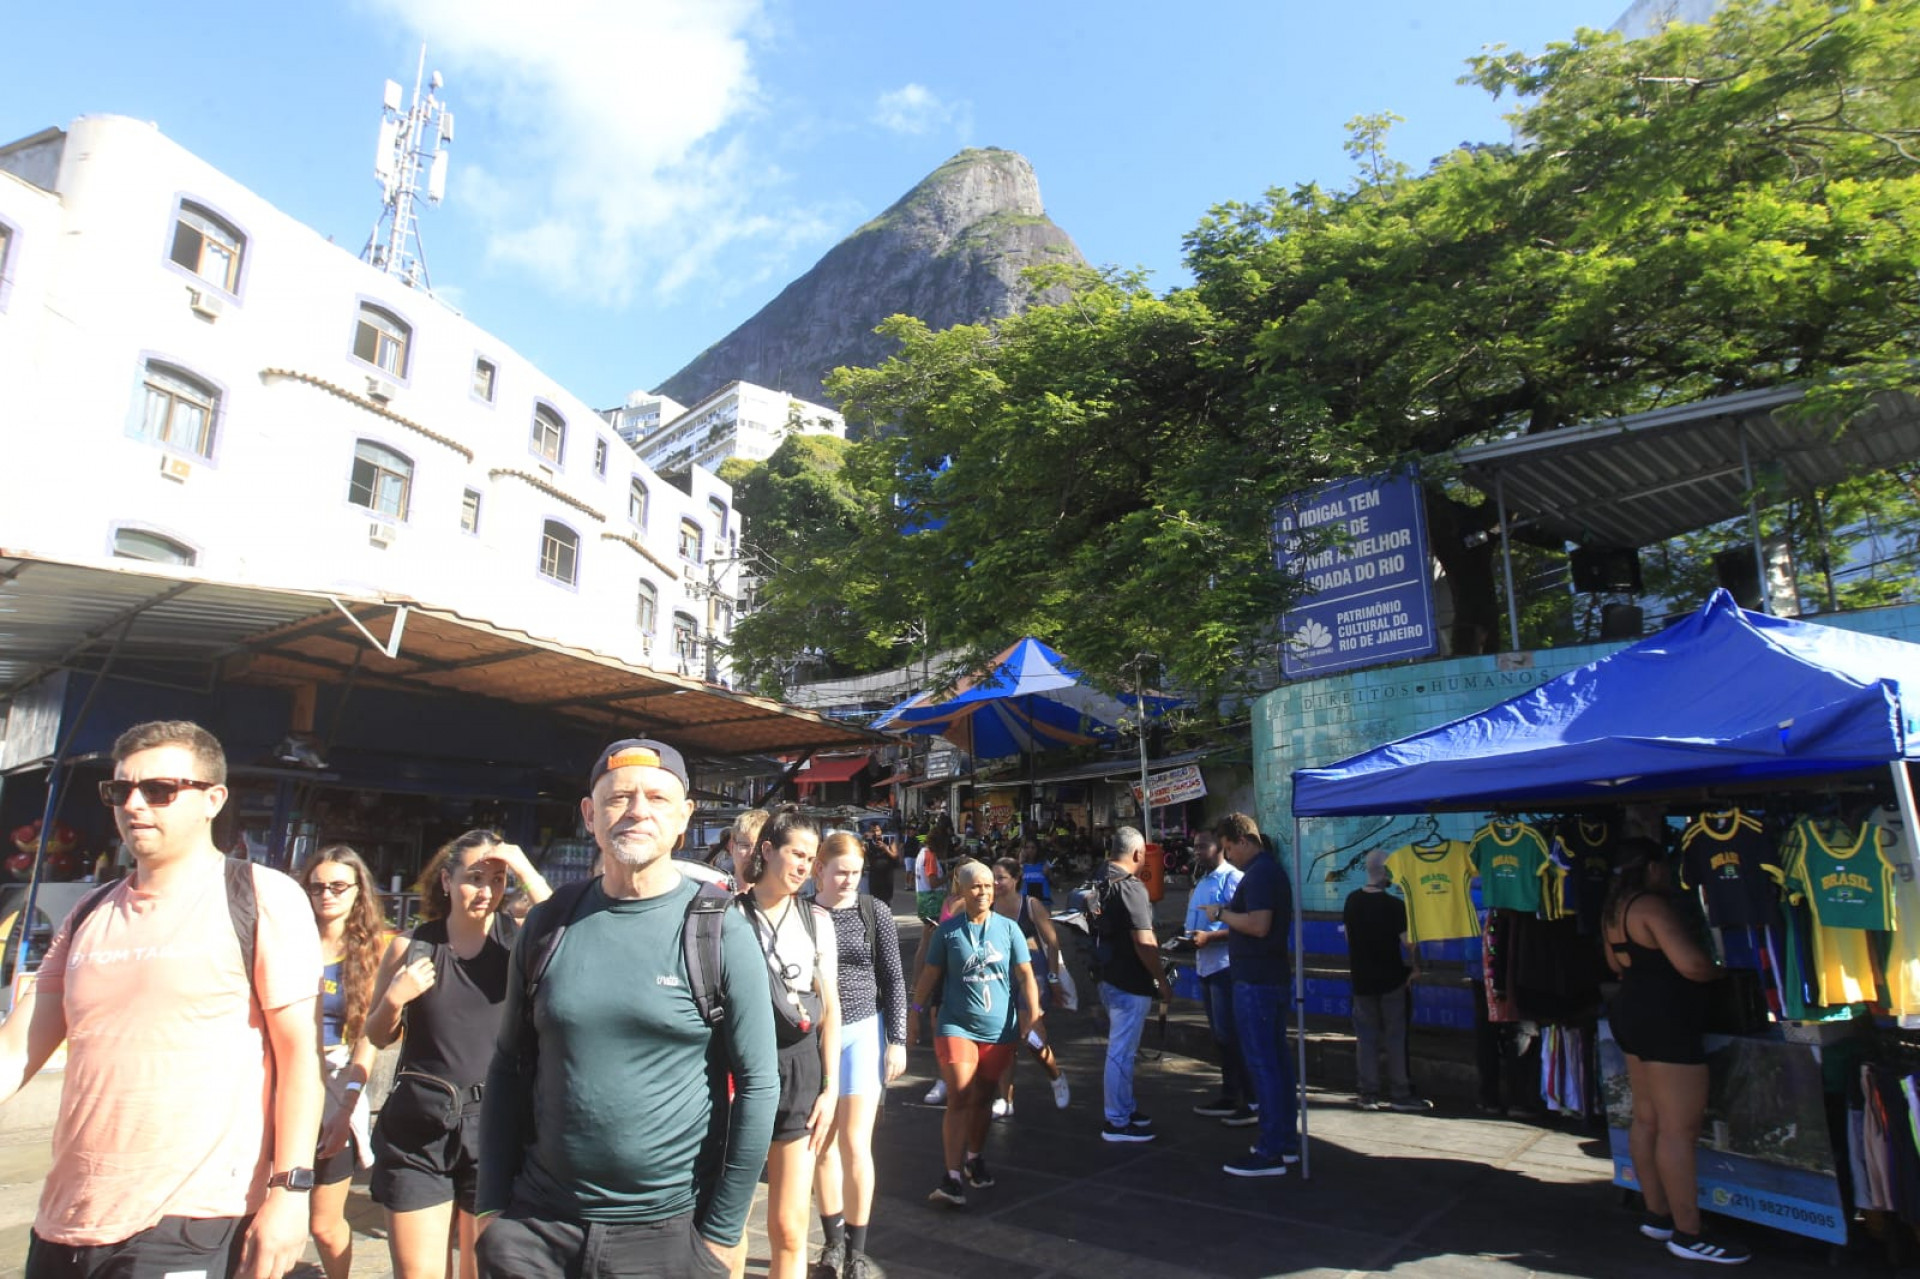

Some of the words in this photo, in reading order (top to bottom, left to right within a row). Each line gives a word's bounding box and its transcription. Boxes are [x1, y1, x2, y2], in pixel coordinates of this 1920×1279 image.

[1282, 516, 1292, 532] O
[1348, 489, 1380, 513] TEM
[1350, 516, 1370, 537] DE
[1349, 528, 1411, 560] MELHOR
[1355, 561, 1376, 583] DO
[1378, 554, 1405, 577] RIO
[1337, 599, 1402, 625] PATRIMÔNIO
[1338, 617, 1391, 638] CULTURAL
[1392, 612, 1408, 626] DO
[1339, 638, 1357, 652] RIO
[1359, 634, 1374, 648] DE
[1376, 624, 1423, 644] JANEIRO
[1304, 686, 1408, 710] DIREITOS
[1432, 669, 1550, 692] HUMANOS
[1821, 872, 1873, 894] BRASIL
[88, 948, 130, 965] TOM
[1731, 1193, 1755, 1212] (21)
[1758, 1198, 1836, 1229] 982700095
